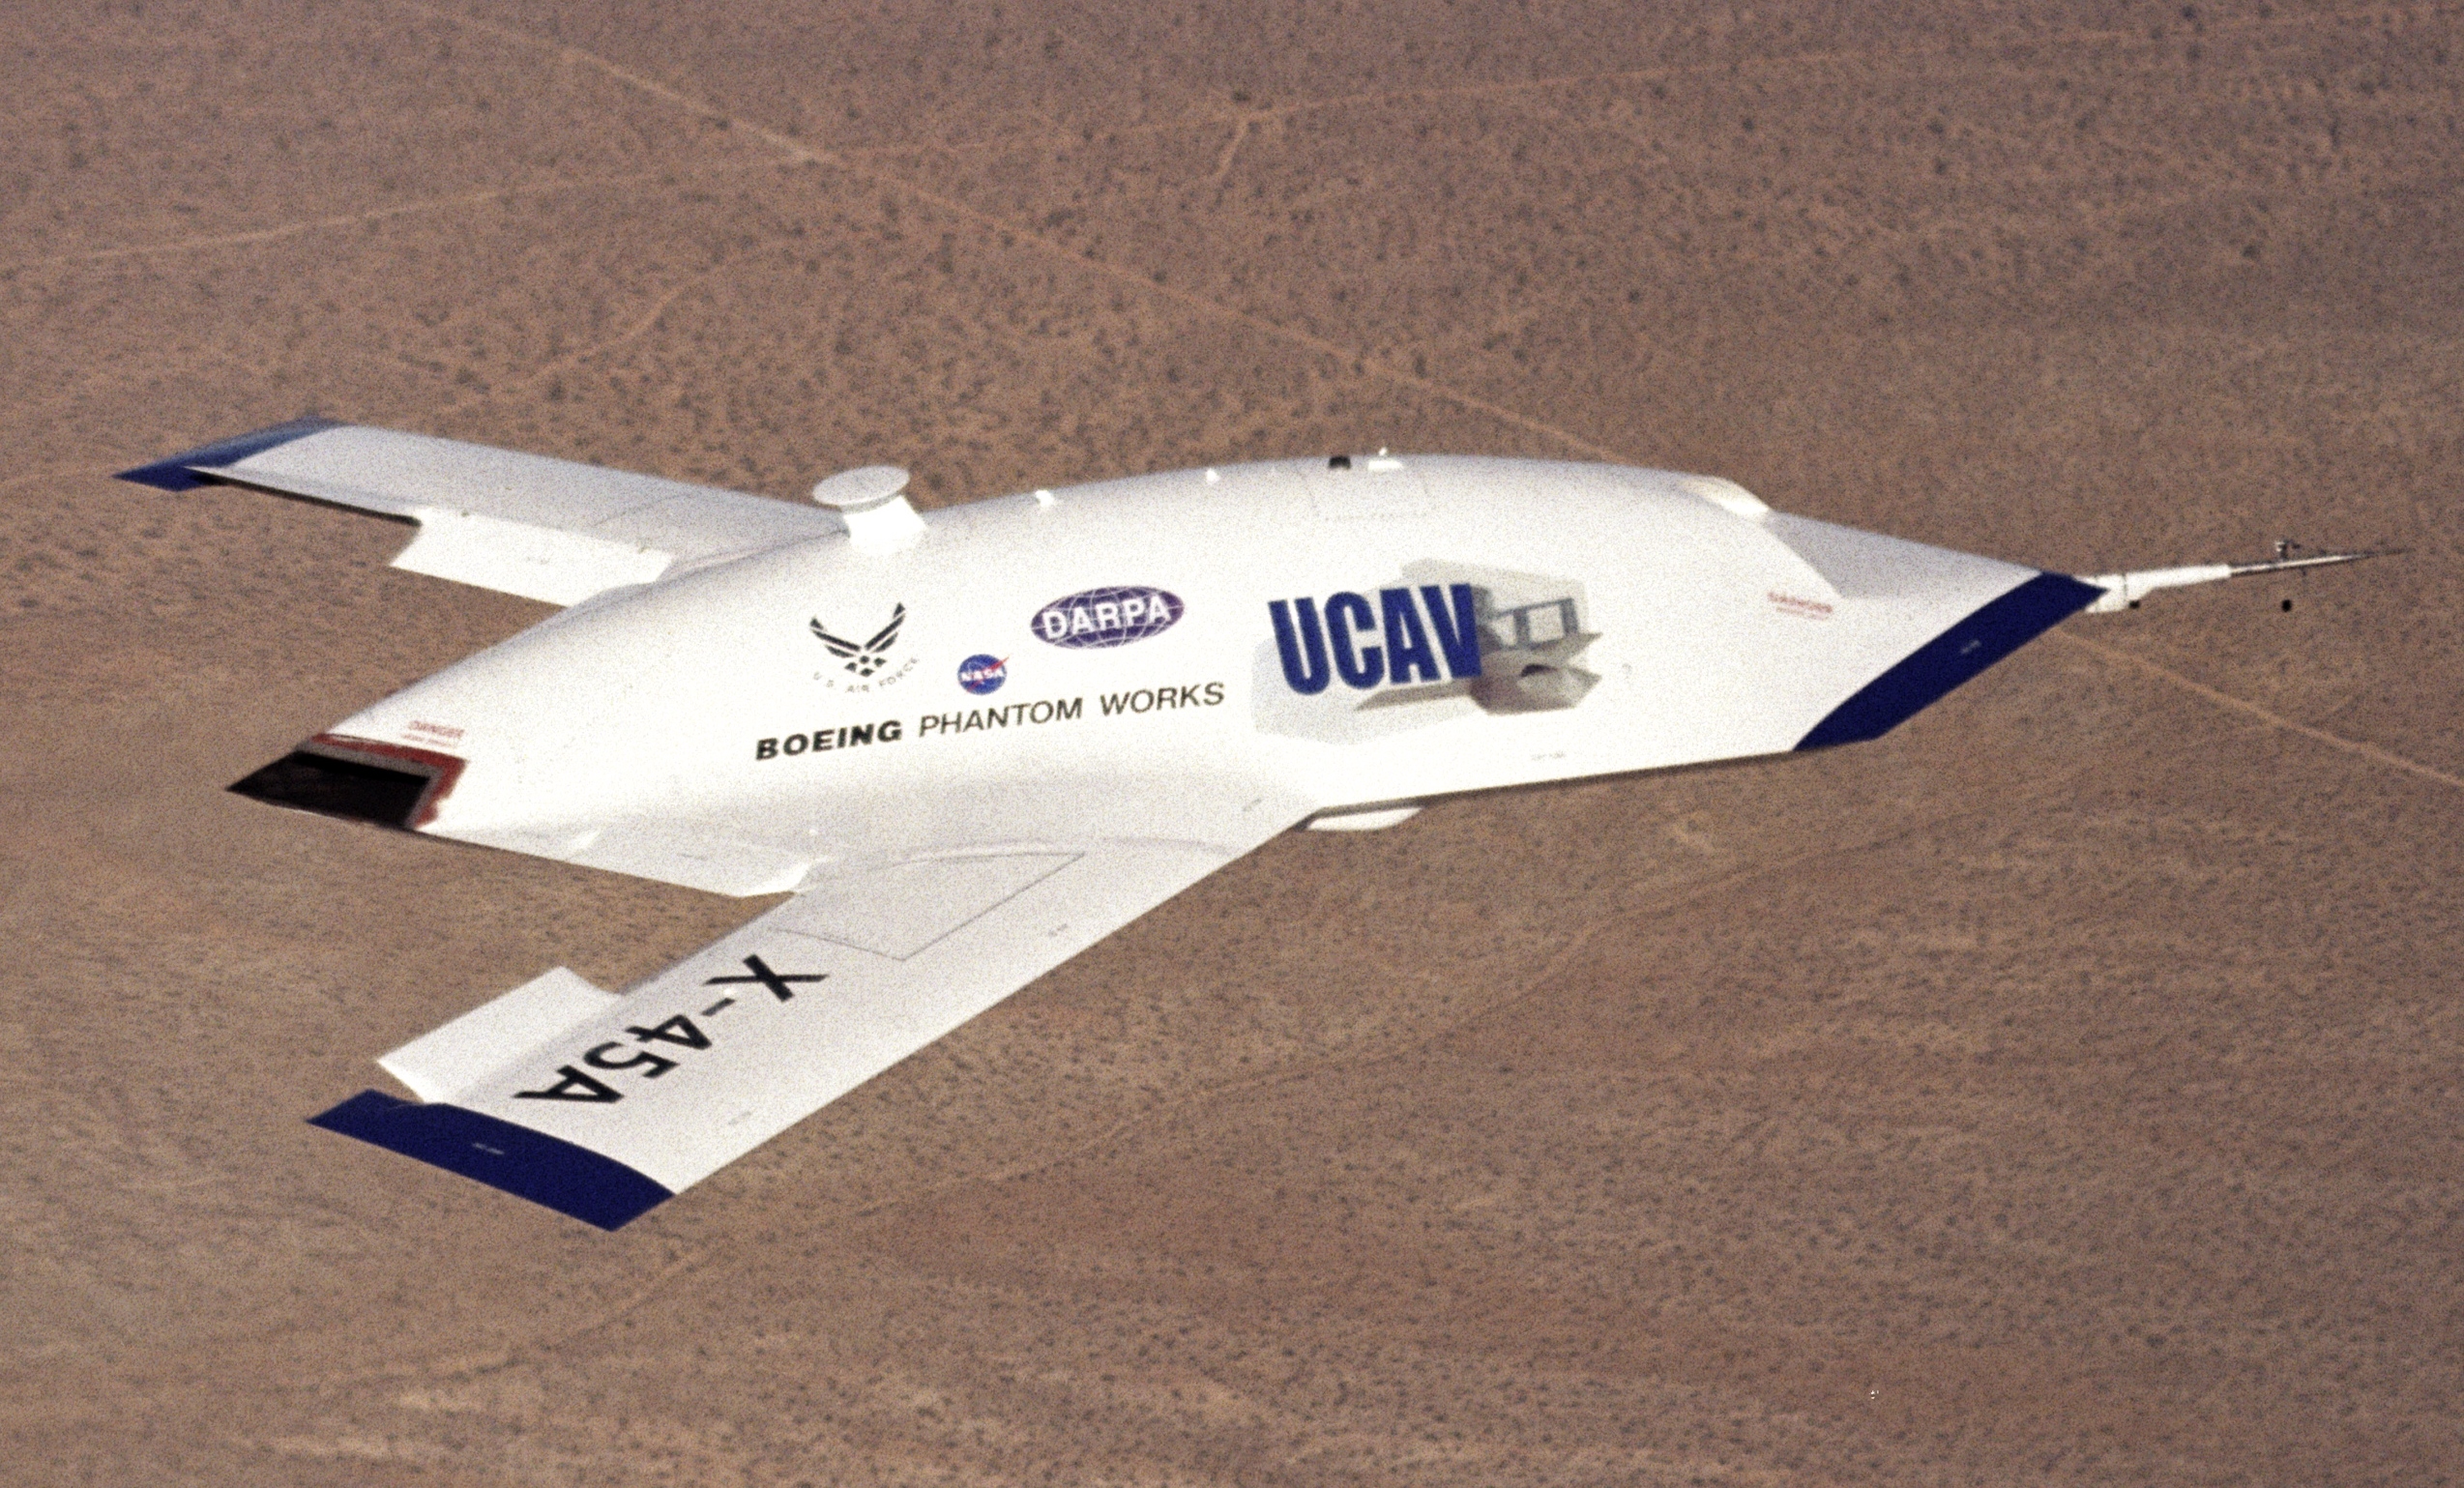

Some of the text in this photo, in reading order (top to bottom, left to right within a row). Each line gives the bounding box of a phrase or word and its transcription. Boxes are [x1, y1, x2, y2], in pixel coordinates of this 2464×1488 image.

[1041, 595, 1172, 639] DARPA
[1267, 583, 1482, 695] UCAV
[877, 656, 921, 689] FORCE
[755, 681, 1225, 762] BOEING PHANTOM WORKS
[513, 953, 830, 1104] X-45A
